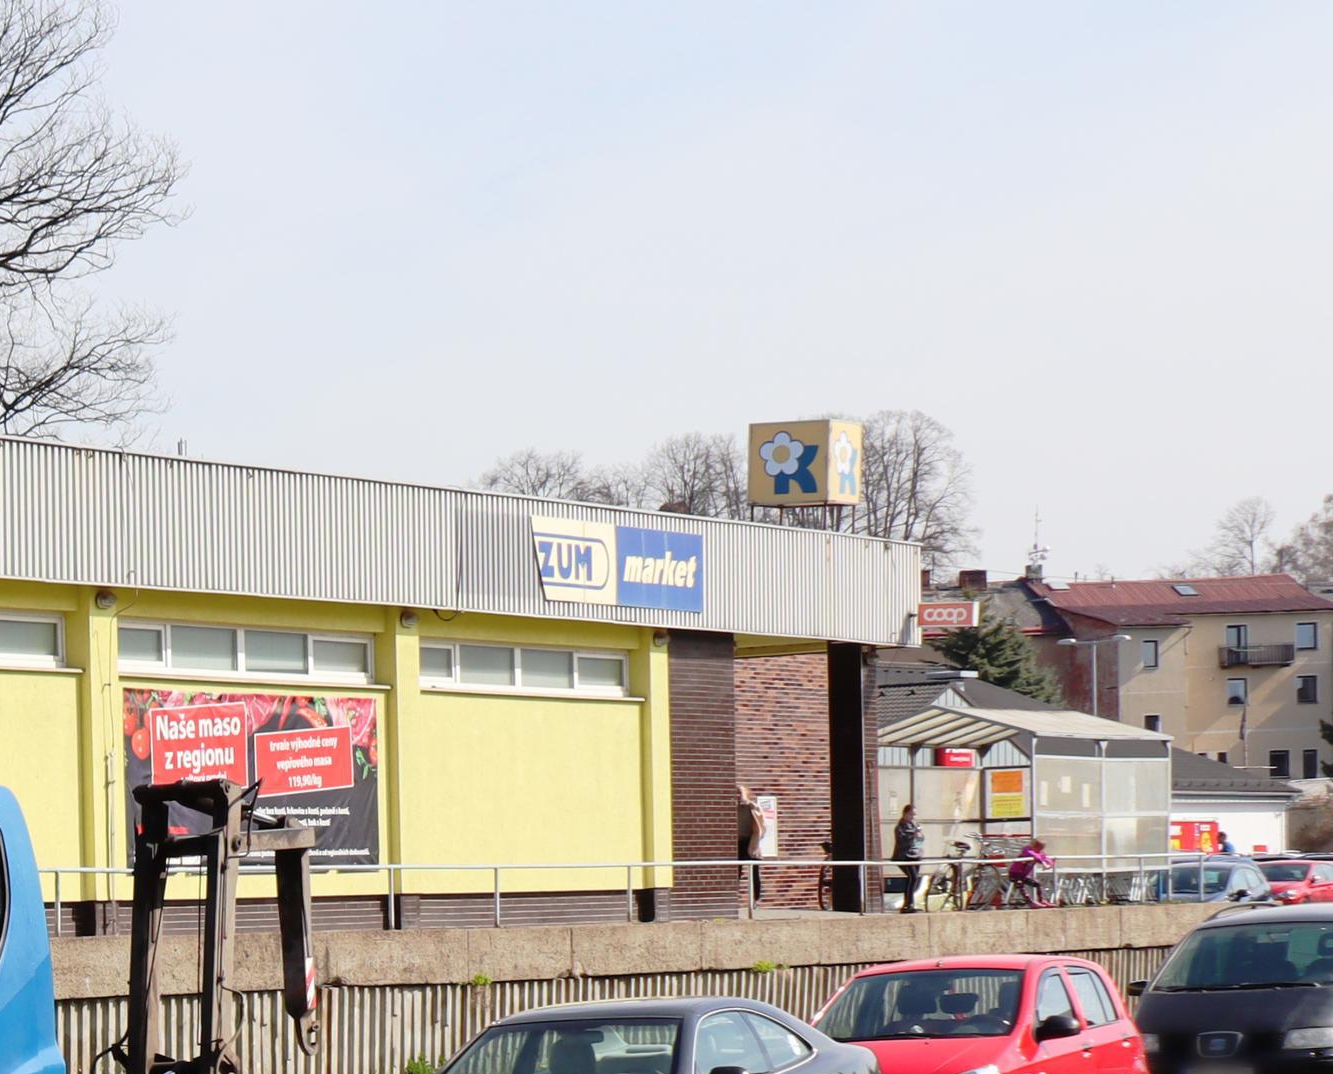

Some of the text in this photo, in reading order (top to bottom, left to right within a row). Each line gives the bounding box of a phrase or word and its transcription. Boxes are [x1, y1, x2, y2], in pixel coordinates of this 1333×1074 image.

[623, 551, 698, 588] market
[923, 608, 967, 624] coop
[156, 713, 241, 741] Naše maso
[164, 742, 235, 774] z regionu
[269, 739, 290, 752] trvale
